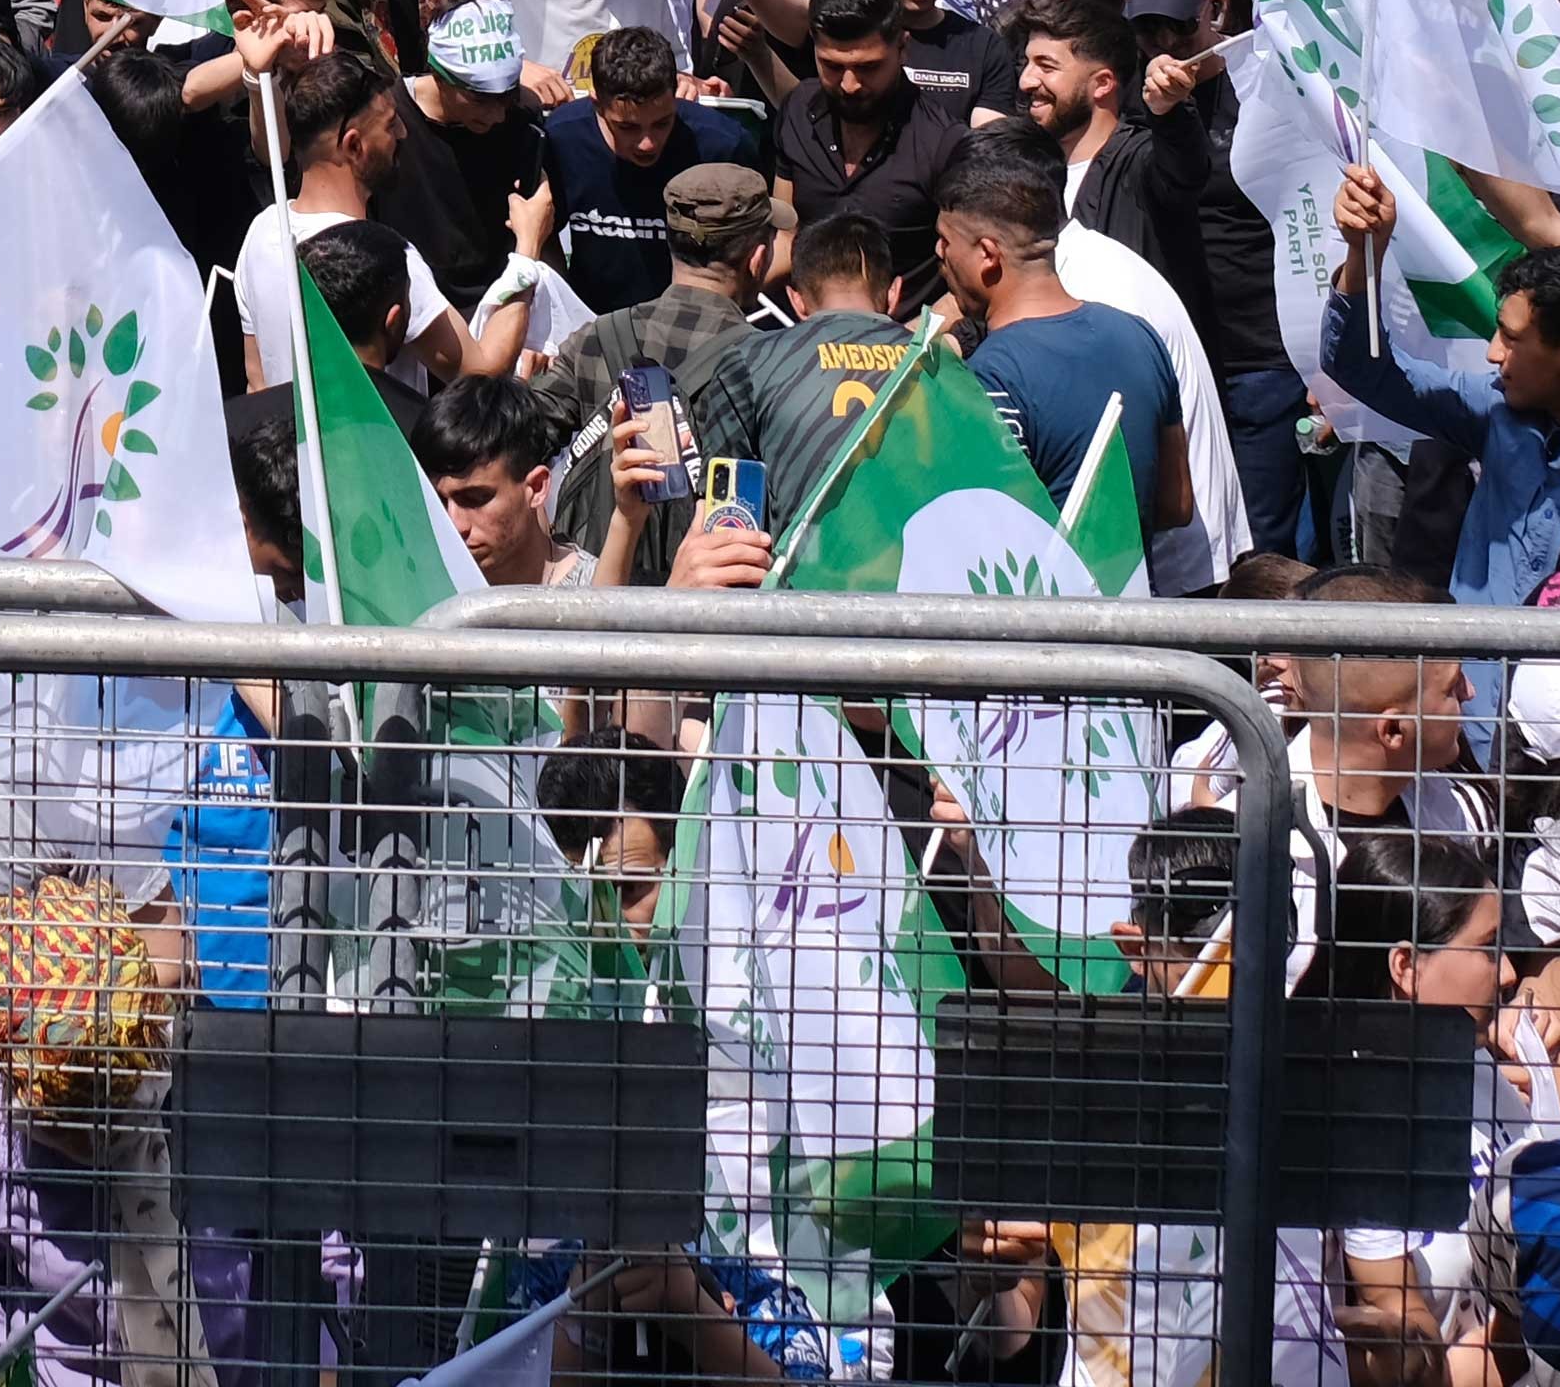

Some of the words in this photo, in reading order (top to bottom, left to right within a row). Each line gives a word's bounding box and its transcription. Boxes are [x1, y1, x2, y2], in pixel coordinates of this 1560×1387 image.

[1282, 208, 1309, 276] PARTİ
[1296, 182, 1322, 247] YEŞİL
[1312, 252, 1332, 297] SOL
